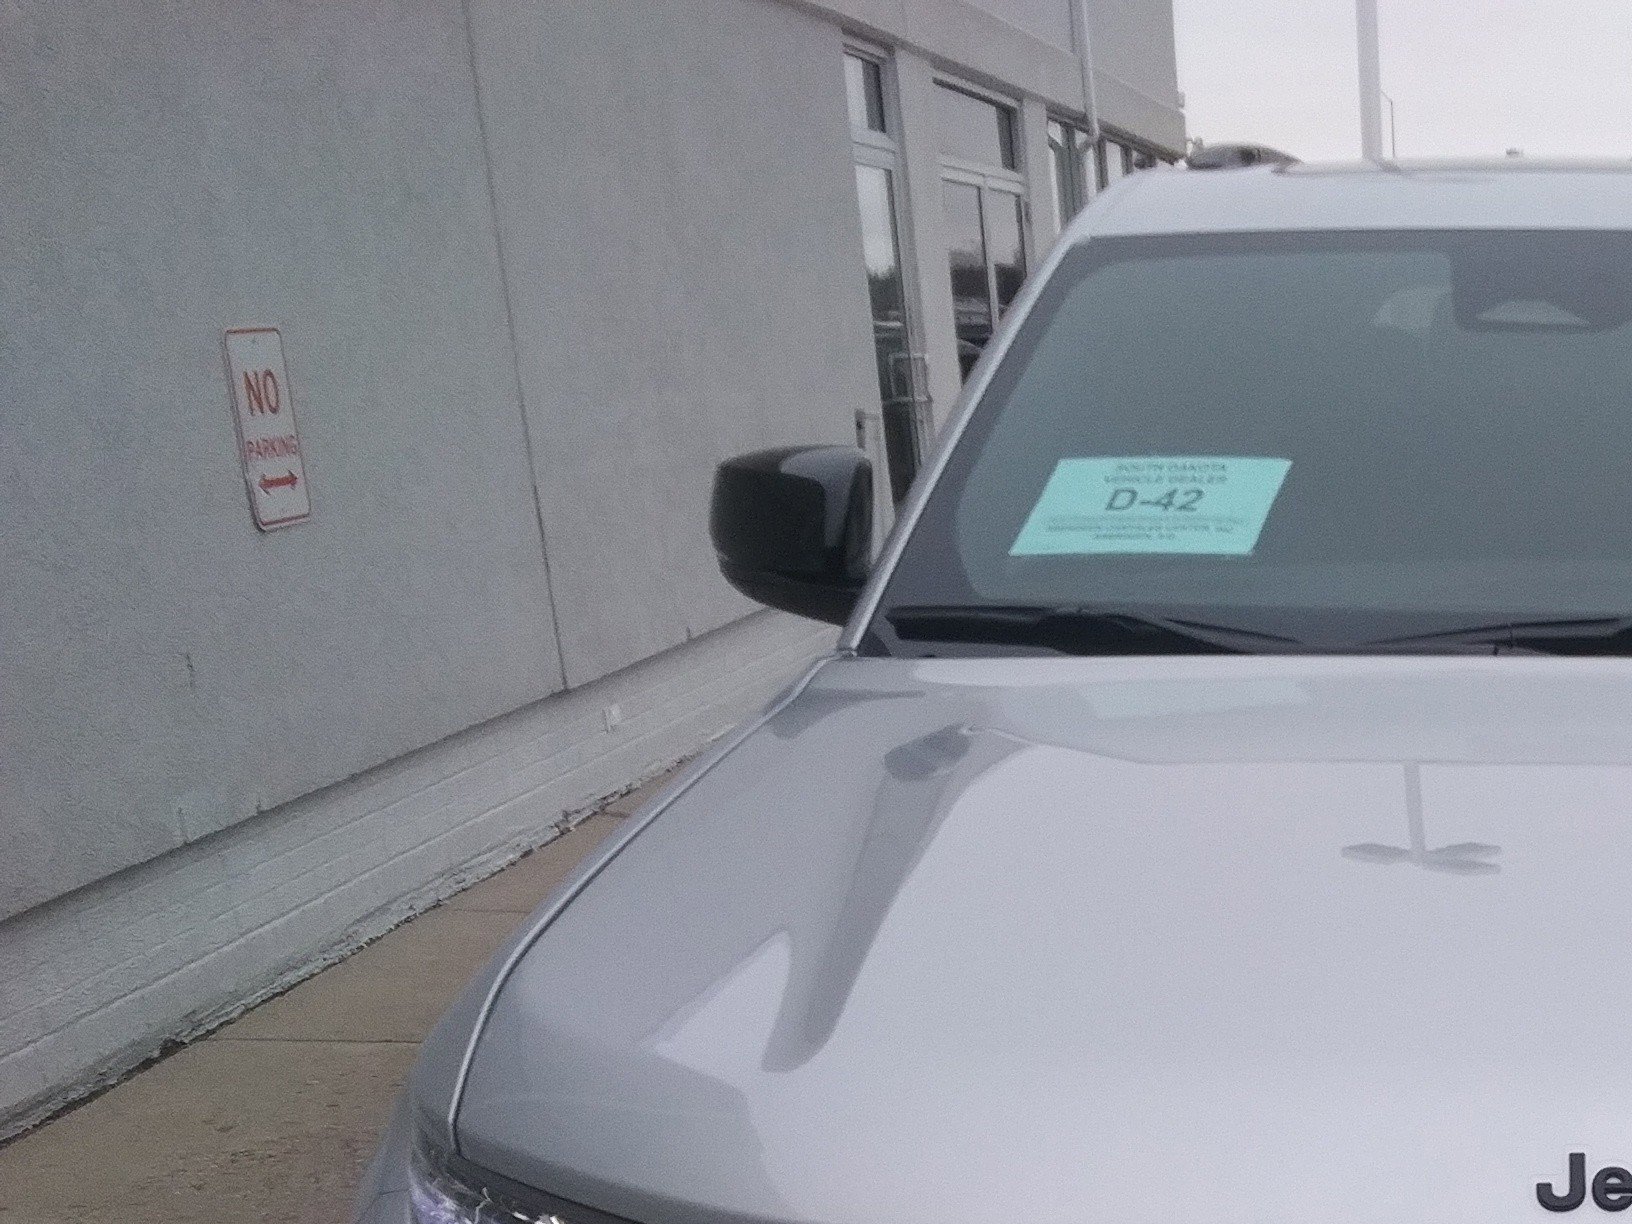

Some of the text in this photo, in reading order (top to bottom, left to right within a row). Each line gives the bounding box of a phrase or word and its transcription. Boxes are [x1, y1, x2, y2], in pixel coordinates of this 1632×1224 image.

[243, 369, 280, 416] NO
[246, 434, 300, 462] PARKING
[1105, 487, 1206, 512] D-42
